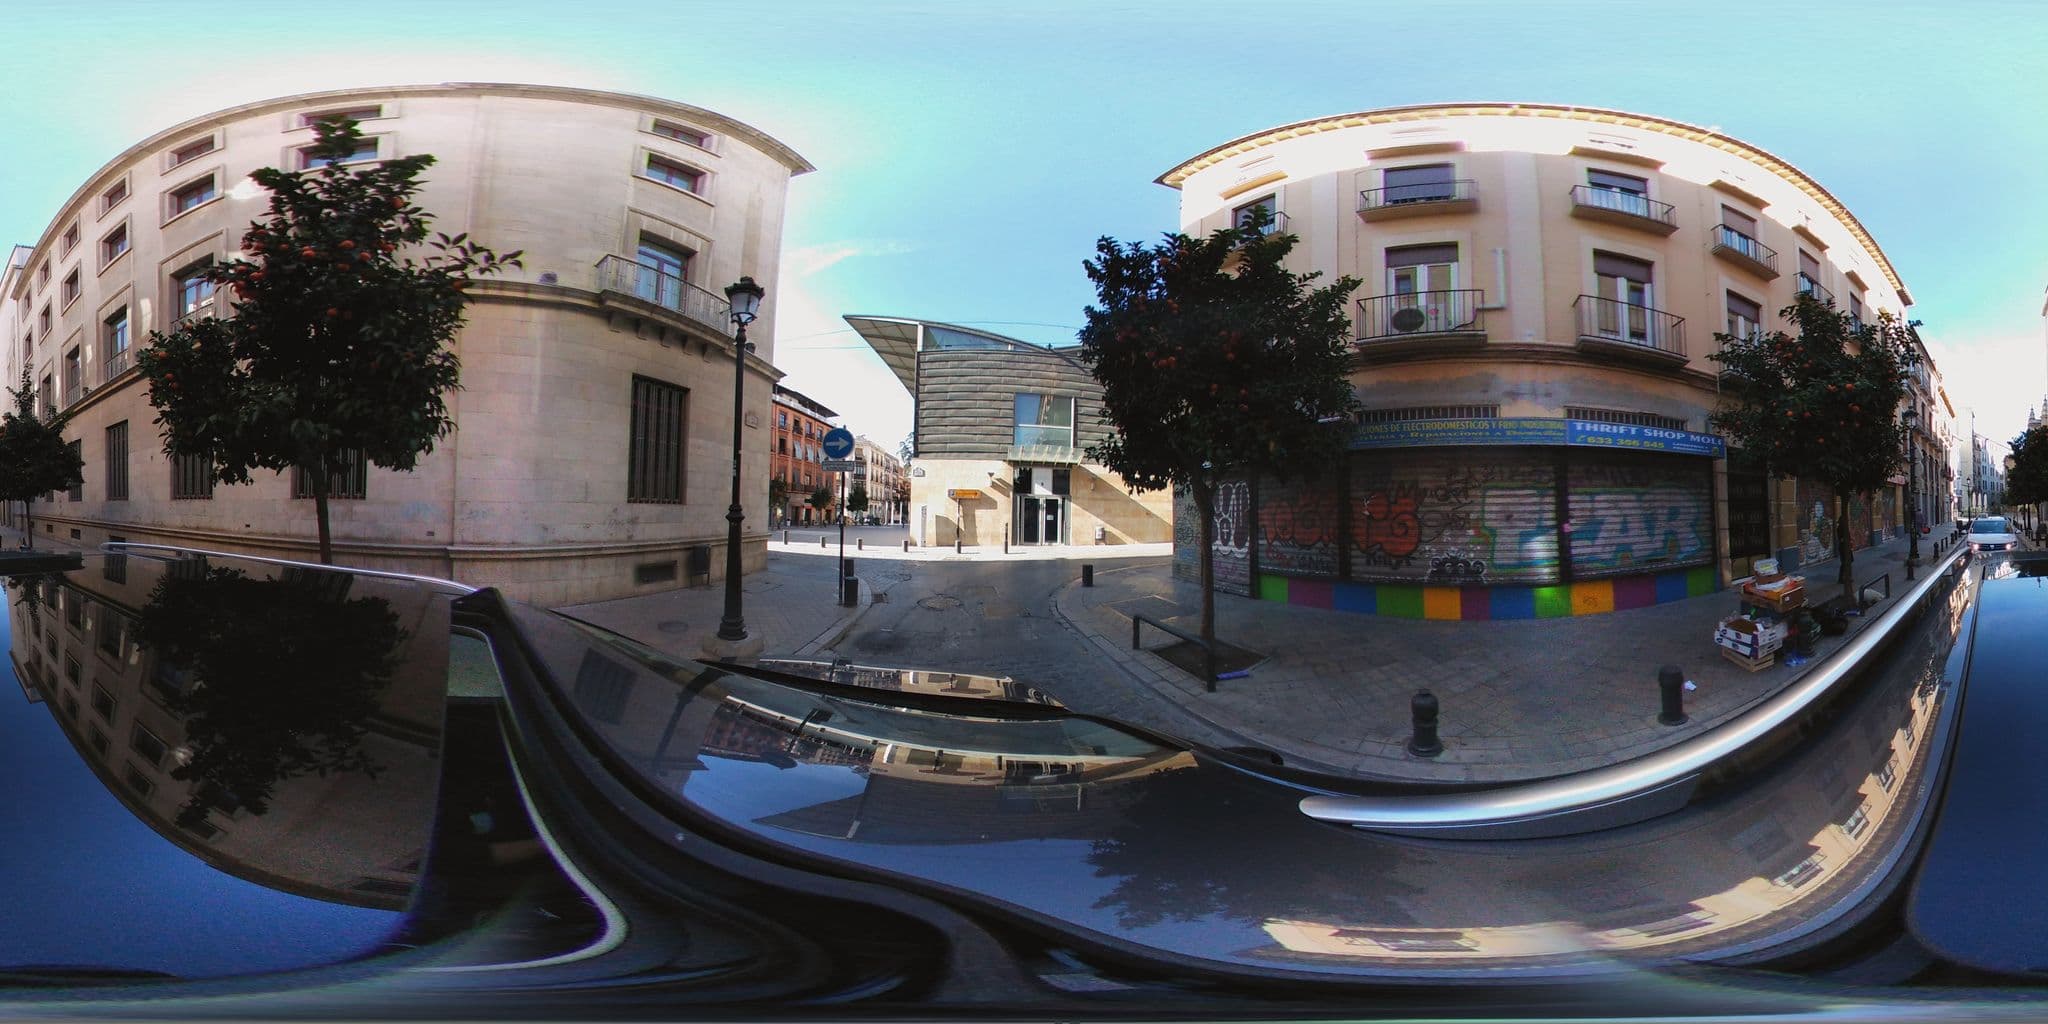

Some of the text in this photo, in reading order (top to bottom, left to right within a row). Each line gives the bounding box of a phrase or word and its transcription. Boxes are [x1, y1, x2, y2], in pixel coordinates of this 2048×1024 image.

[1390, 423, 1401, 433] DE
[1573, 422, 1638, 435] THRIFT
[1644, 428, 1686, 440] SHOP
